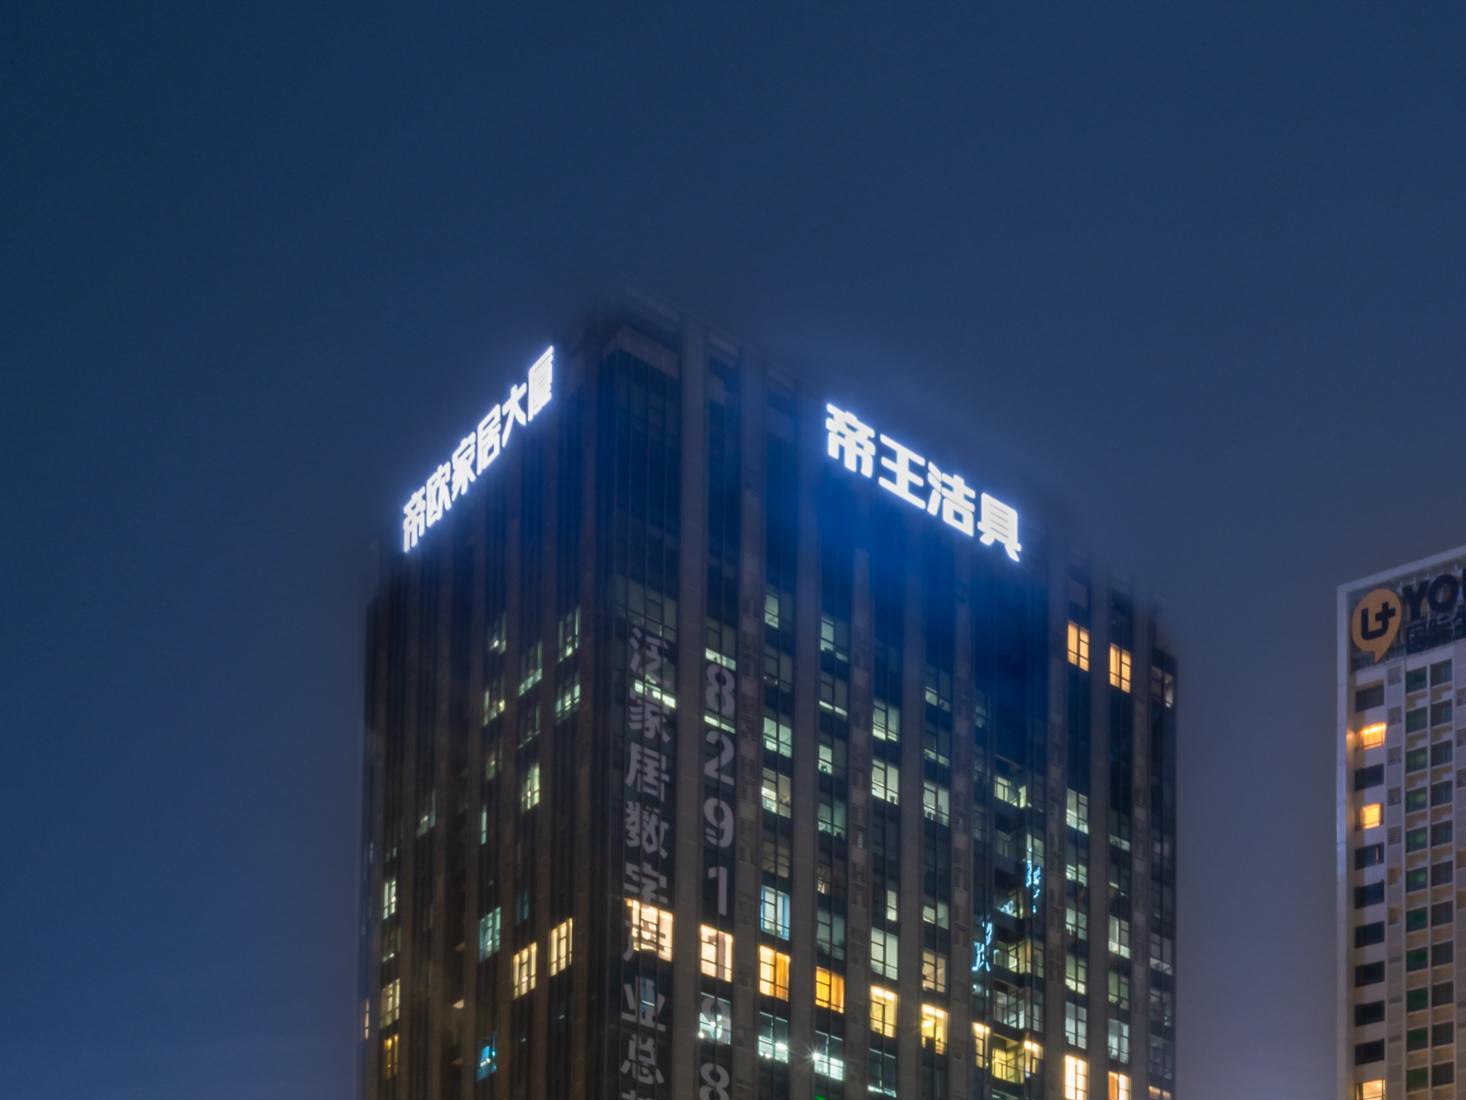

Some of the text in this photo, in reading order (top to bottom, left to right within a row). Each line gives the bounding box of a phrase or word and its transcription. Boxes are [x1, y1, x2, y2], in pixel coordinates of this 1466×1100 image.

[402, 345, 555, 554] 帝欧家居大厦
[825, 401, 1022, 562] 帝王洁具
